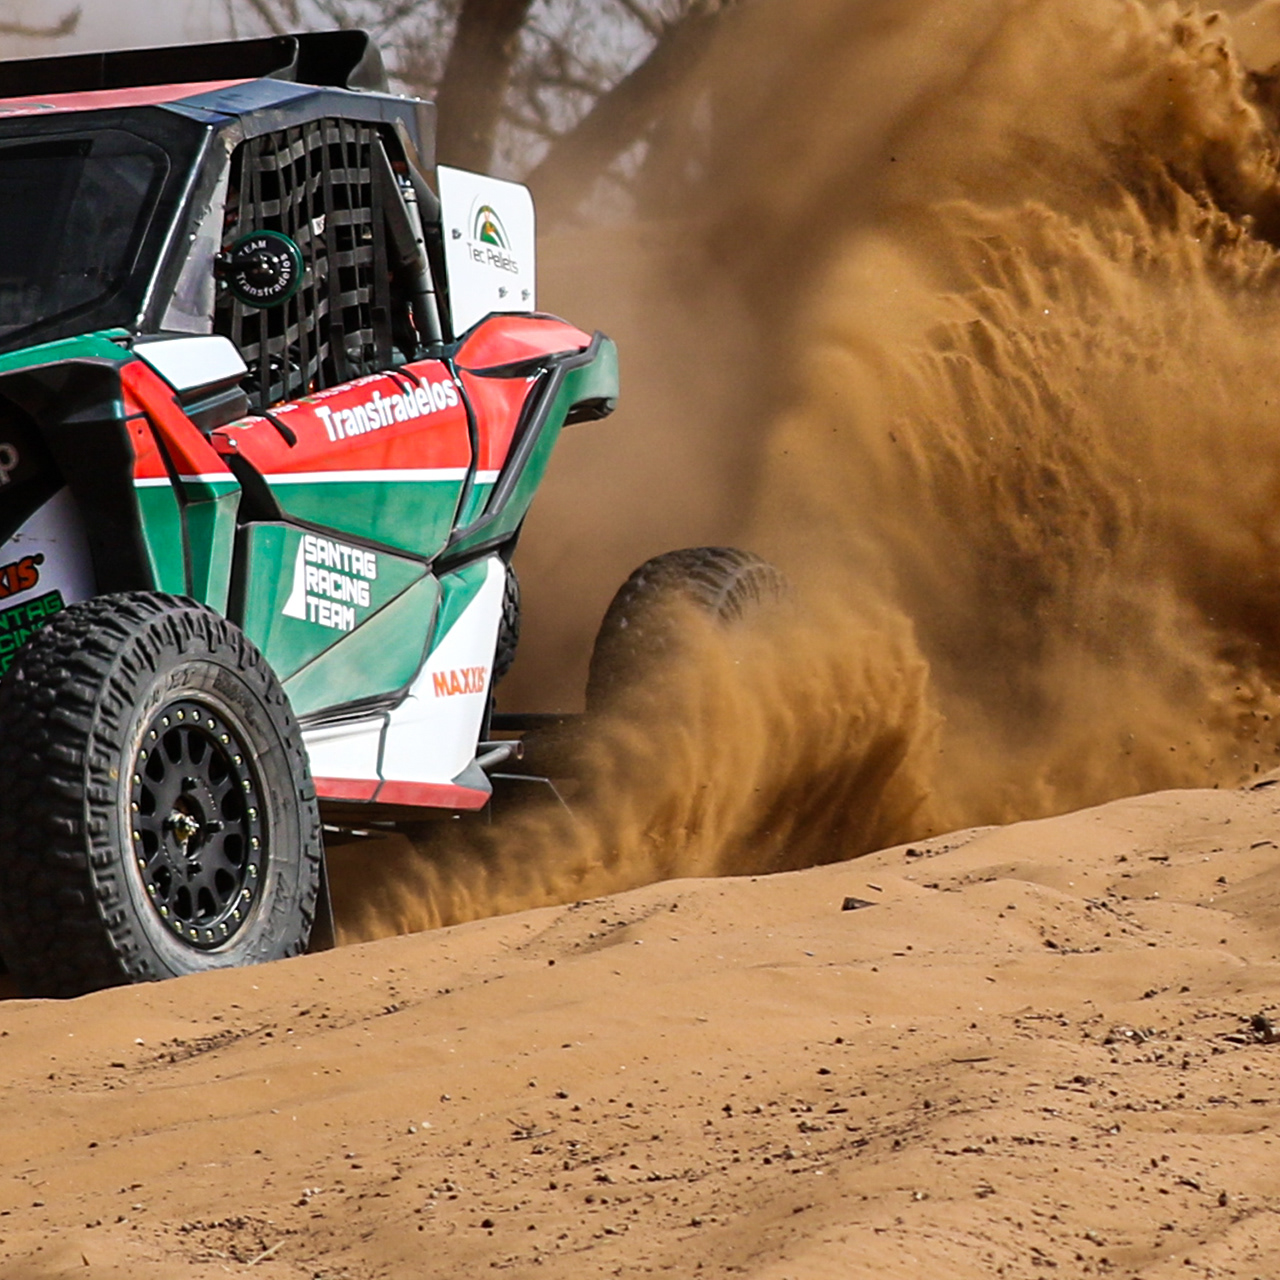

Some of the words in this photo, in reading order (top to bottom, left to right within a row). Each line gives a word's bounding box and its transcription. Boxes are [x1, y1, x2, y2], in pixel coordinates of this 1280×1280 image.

[466, 241, 486, 265] Tec
[486, 248, 519, 275] Pellets
[314, 377, 460, 442] Transfradelos
[304, 534, 377, 580] SANTAG
[305, 564, 370, 608] RACING
[306, 595, 355, 631] TEAM
[432, 666, 486, 698] MAXXIS
